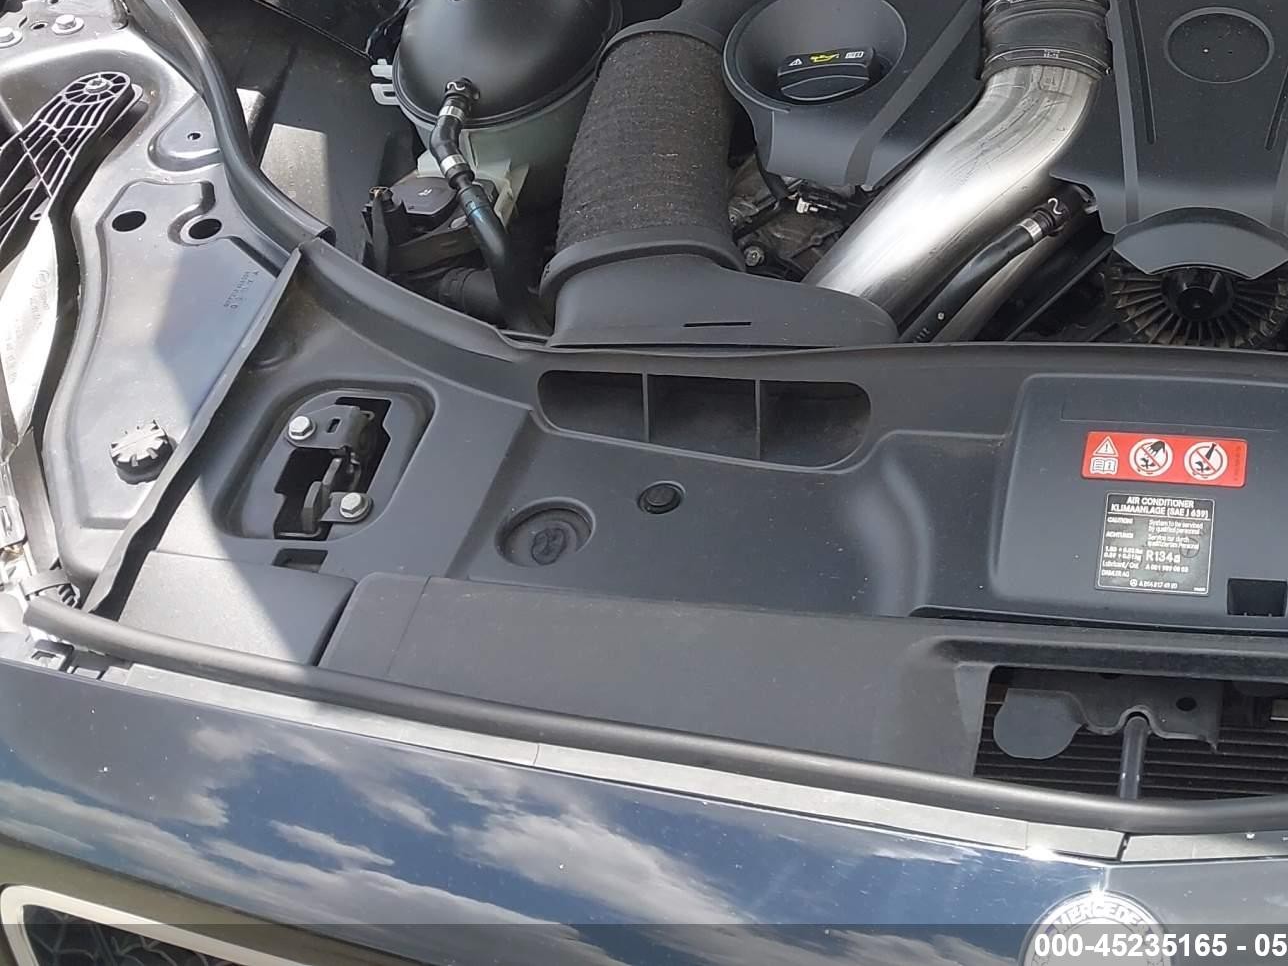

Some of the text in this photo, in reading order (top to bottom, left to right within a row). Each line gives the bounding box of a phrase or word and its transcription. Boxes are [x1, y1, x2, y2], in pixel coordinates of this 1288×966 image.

[1110, 503, 1166, 515] KLIMAANLAGE
[1126, 496, 1194, 509] AIR CONDITIONER
[1146, 550, 1181, 563] R134a
